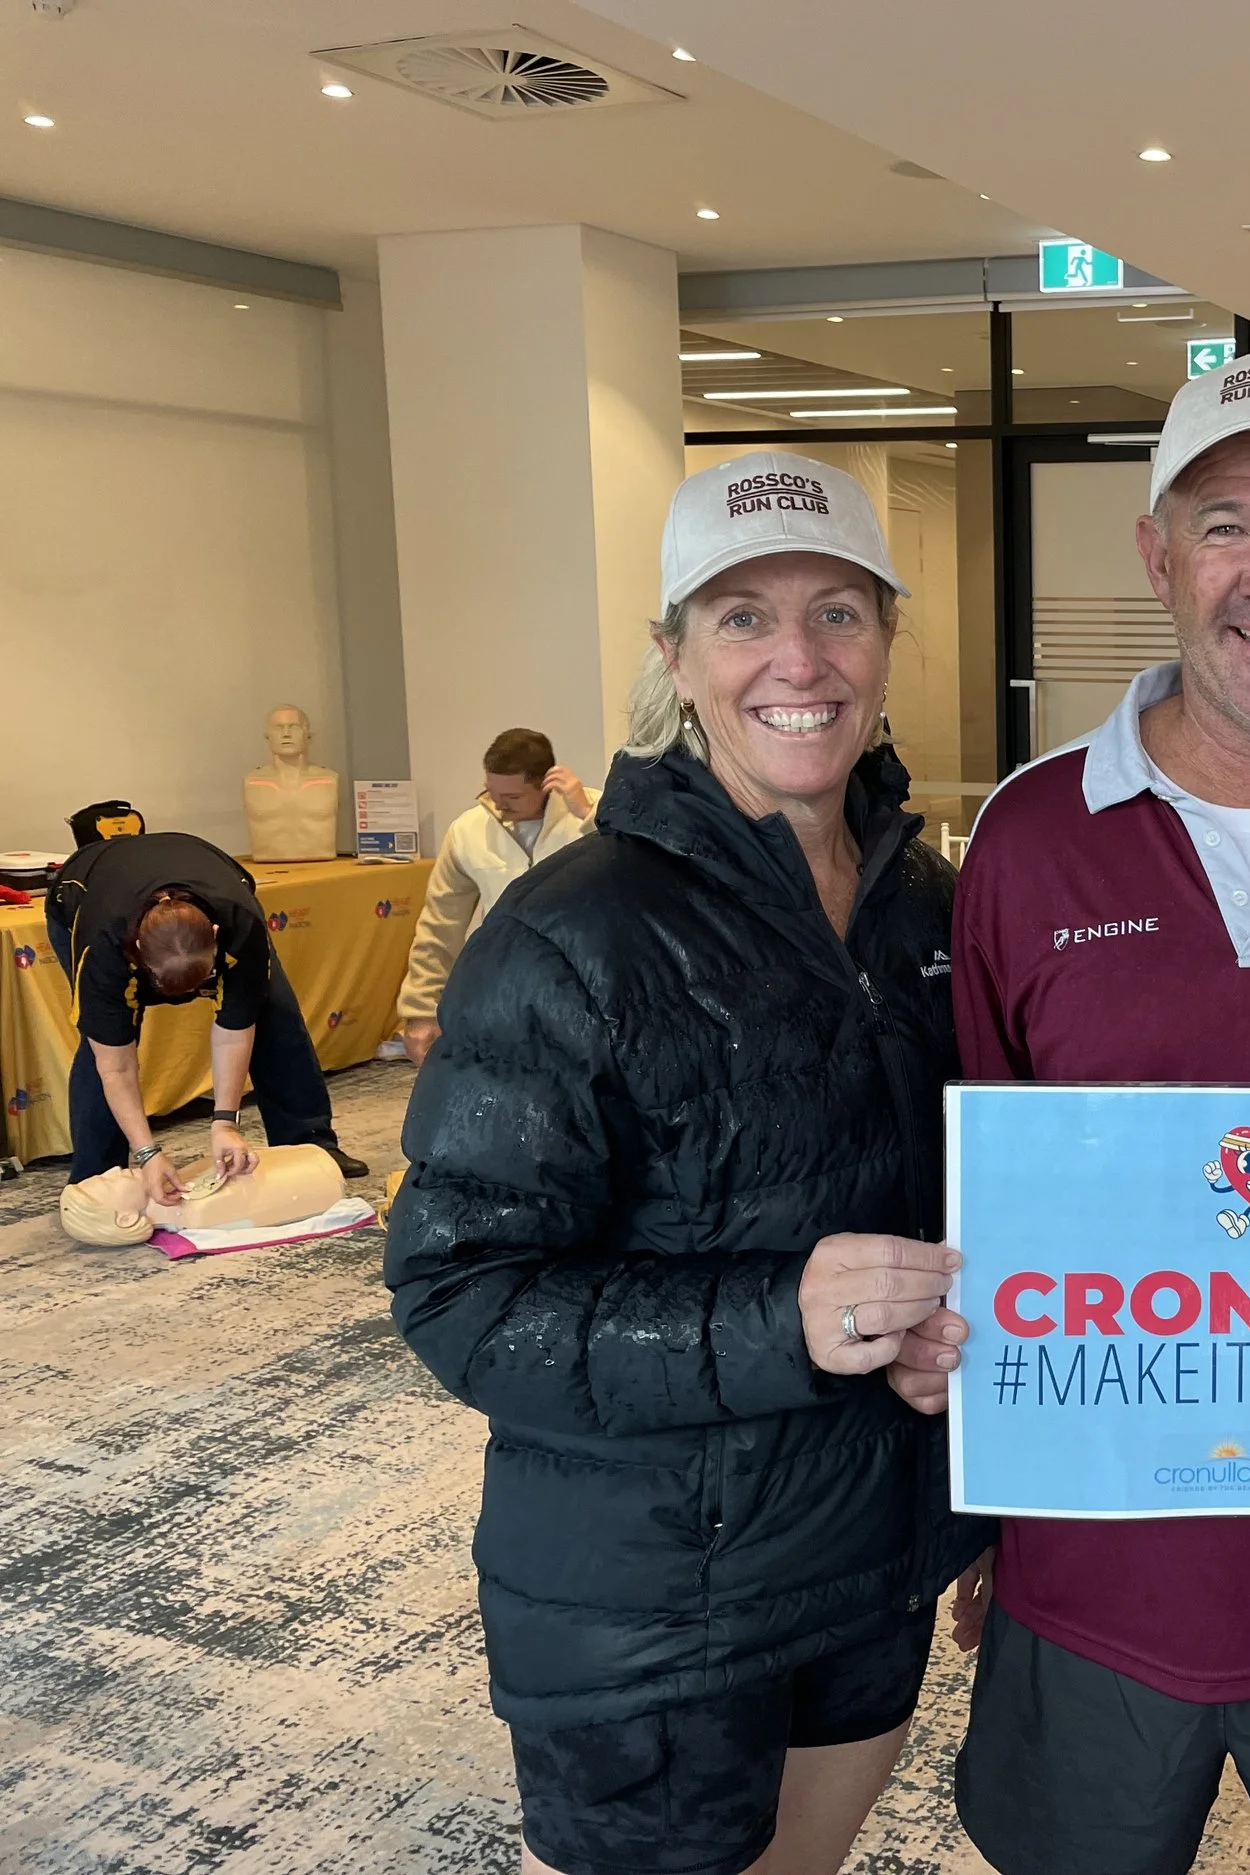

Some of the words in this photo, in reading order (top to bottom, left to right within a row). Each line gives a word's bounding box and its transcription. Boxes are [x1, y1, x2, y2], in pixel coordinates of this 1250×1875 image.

[727, 473, 824, 498] ROSSCO'S
[729, 497, 772, 518] RUN
[777, 496, 829, 515] CLUB
[1073, 917, 1160, 944] ENGINE
